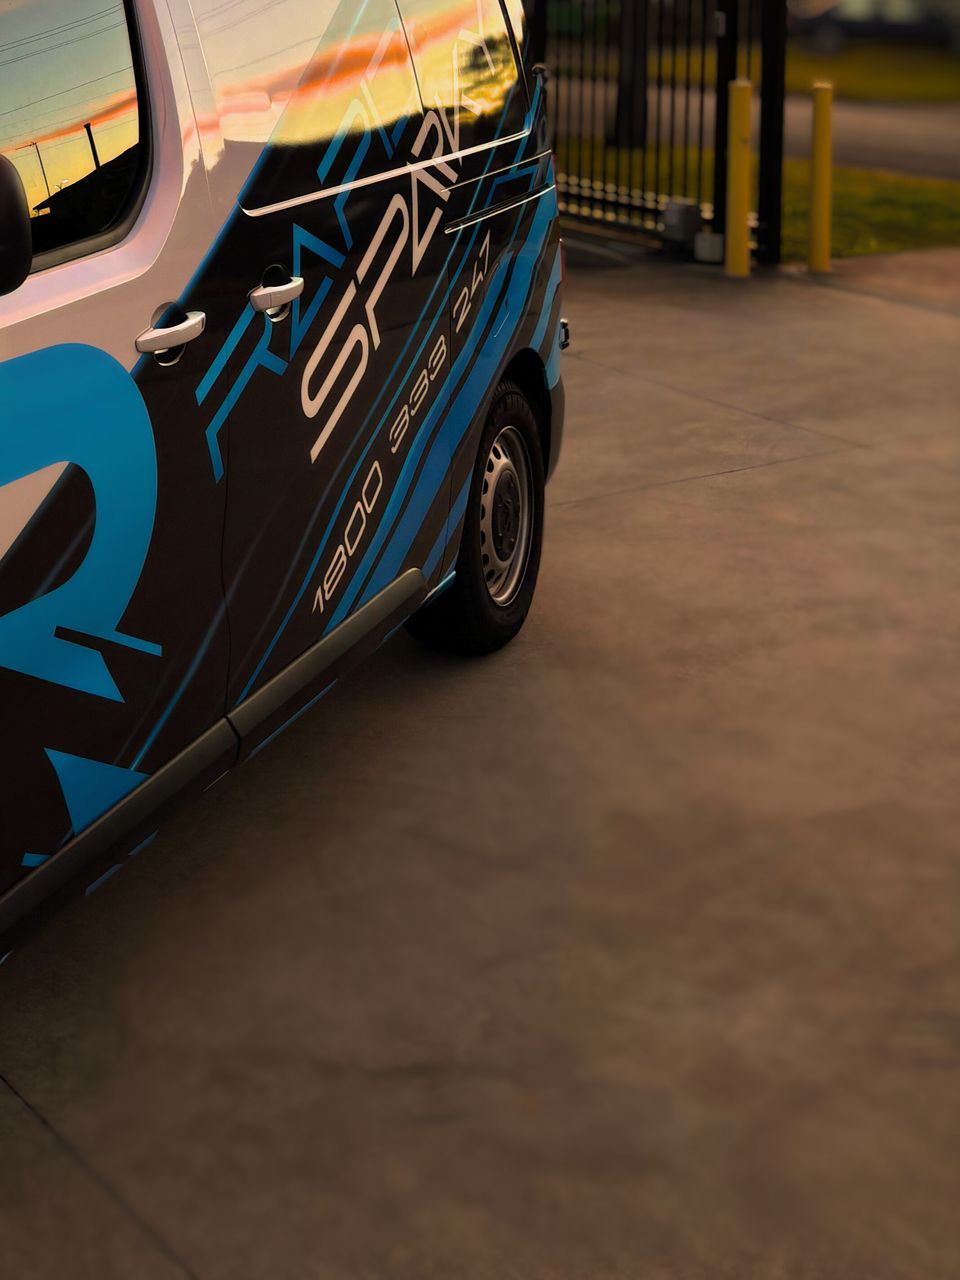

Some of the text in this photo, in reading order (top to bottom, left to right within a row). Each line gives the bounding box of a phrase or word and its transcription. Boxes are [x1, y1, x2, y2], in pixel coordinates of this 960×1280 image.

[311, 228, 491, 614] 1800 333 247
